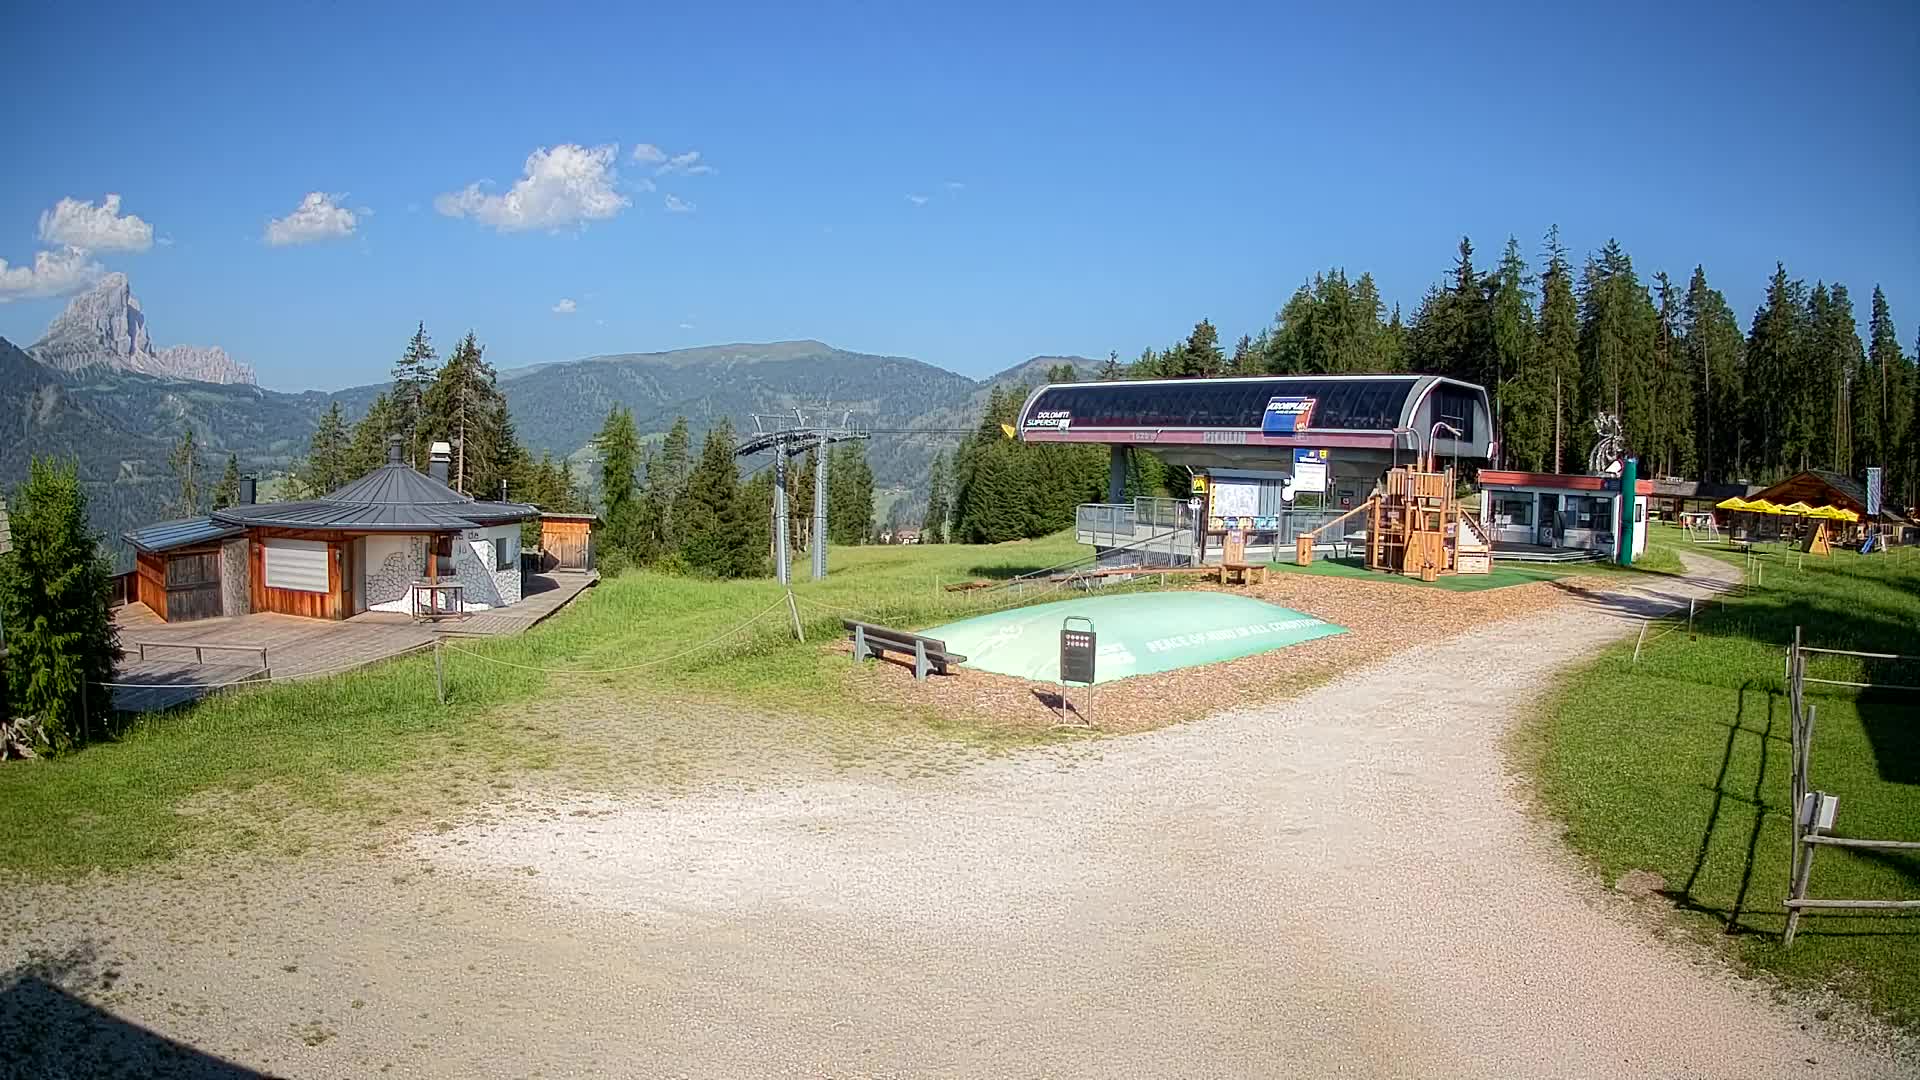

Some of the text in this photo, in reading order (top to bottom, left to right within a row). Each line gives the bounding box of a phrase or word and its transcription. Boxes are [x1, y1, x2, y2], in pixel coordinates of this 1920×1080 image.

[1037, 411, 1070, 419] DOLOMITI
[1146, 635, 1191, 653] PEACE
[1189, 632, 1207, 647] OF
[1249, 624, 1271, 635] ALL
